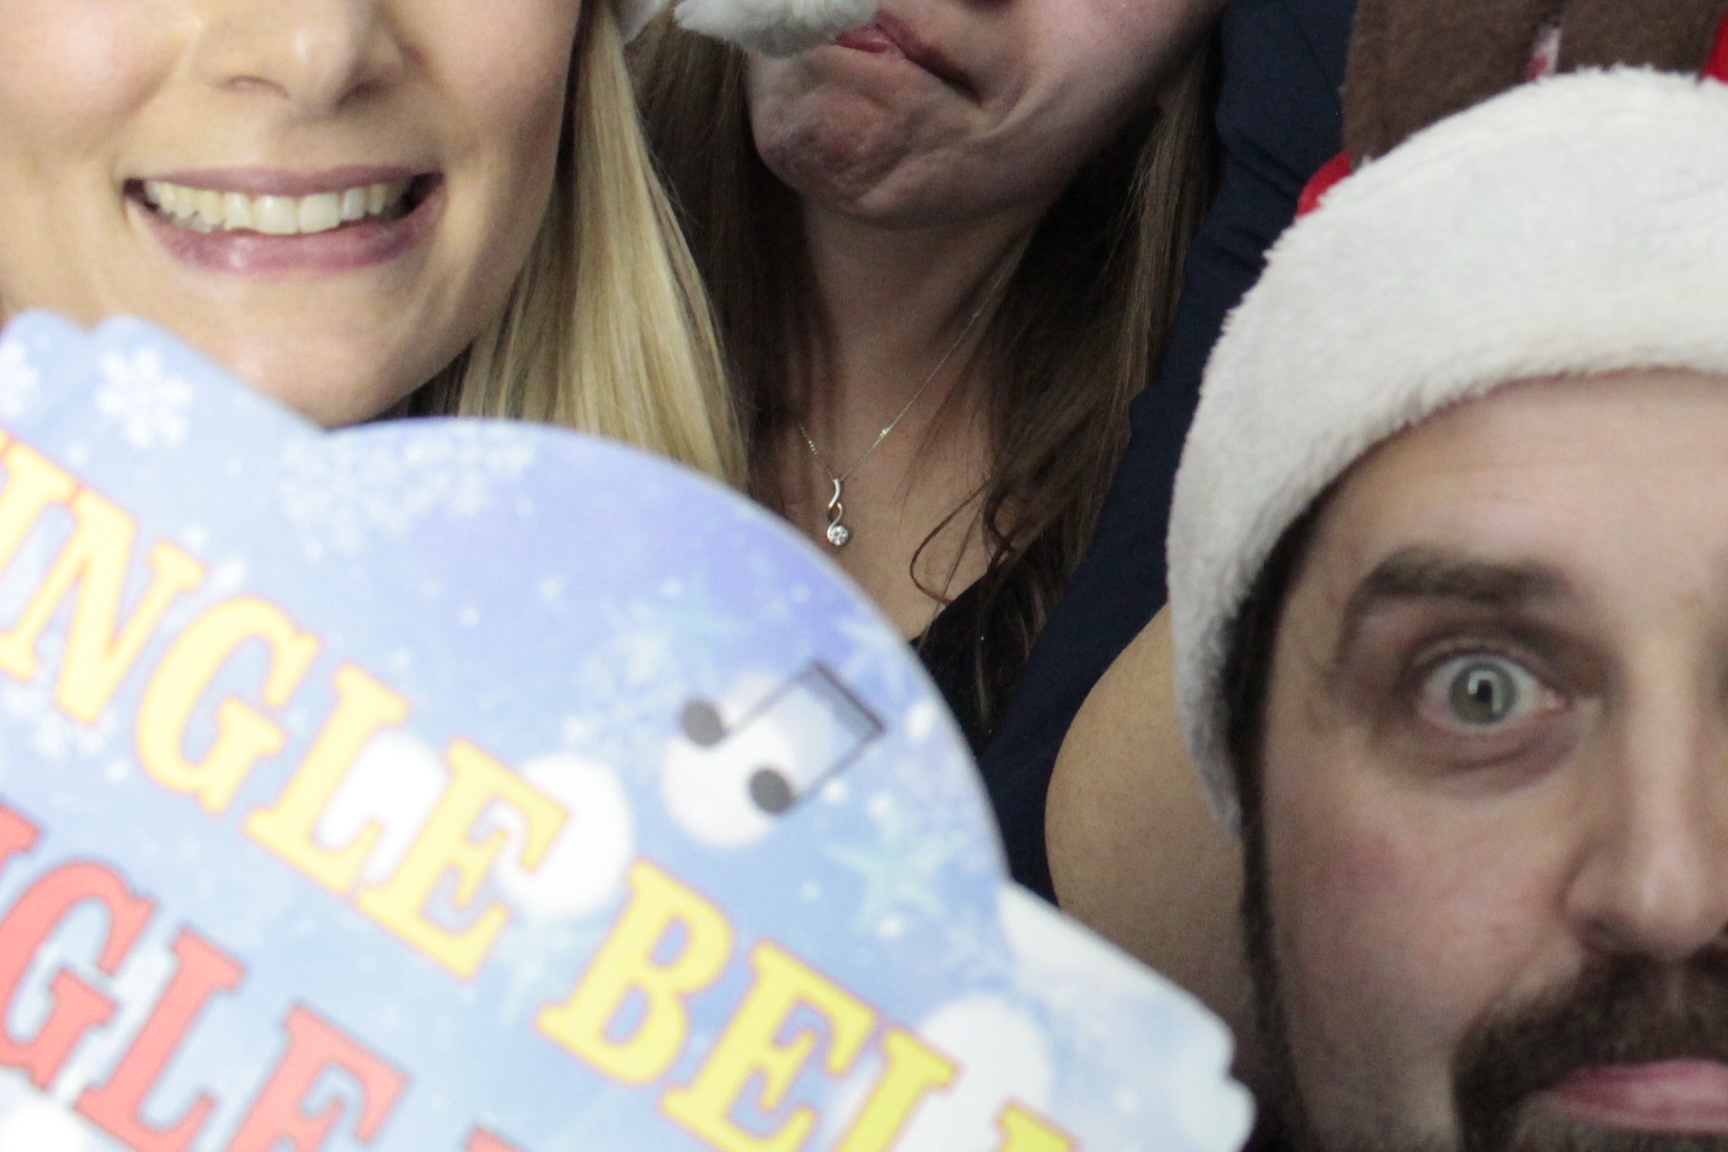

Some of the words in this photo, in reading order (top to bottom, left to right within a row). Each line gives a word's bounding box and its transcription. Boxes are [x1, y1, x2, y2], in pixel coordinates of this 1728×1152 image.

[0, 426, 571, 981] INGLE
[536, 858, 1078, 1152] BEL
[0, 801, 411, 1152] GLE
